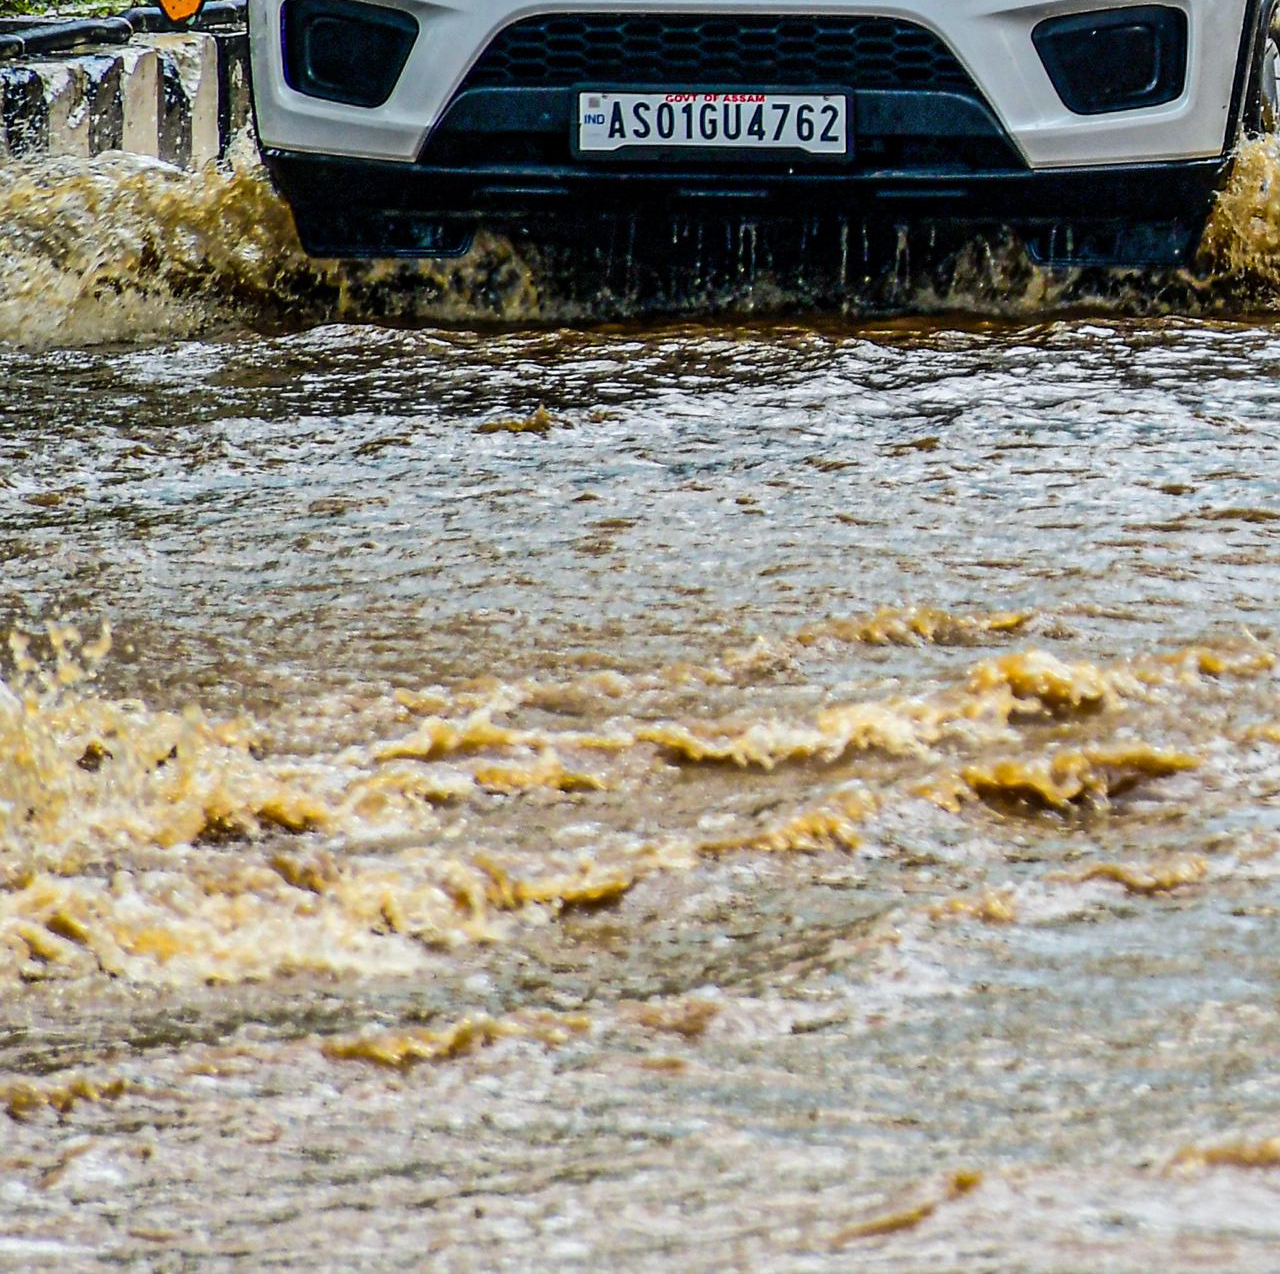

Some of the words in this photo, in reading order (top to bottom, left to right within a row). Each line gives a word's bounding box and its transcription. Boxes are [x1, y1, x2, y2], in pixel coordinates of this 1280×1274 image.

[665, 94, 698, 103] GOVT
[704, 94, 720, 103] OF
[723, 94, 766, 103] ASSAM
[584, 114, 605, 126] IND
[608, 101, 840, 143] AS01GU4762
